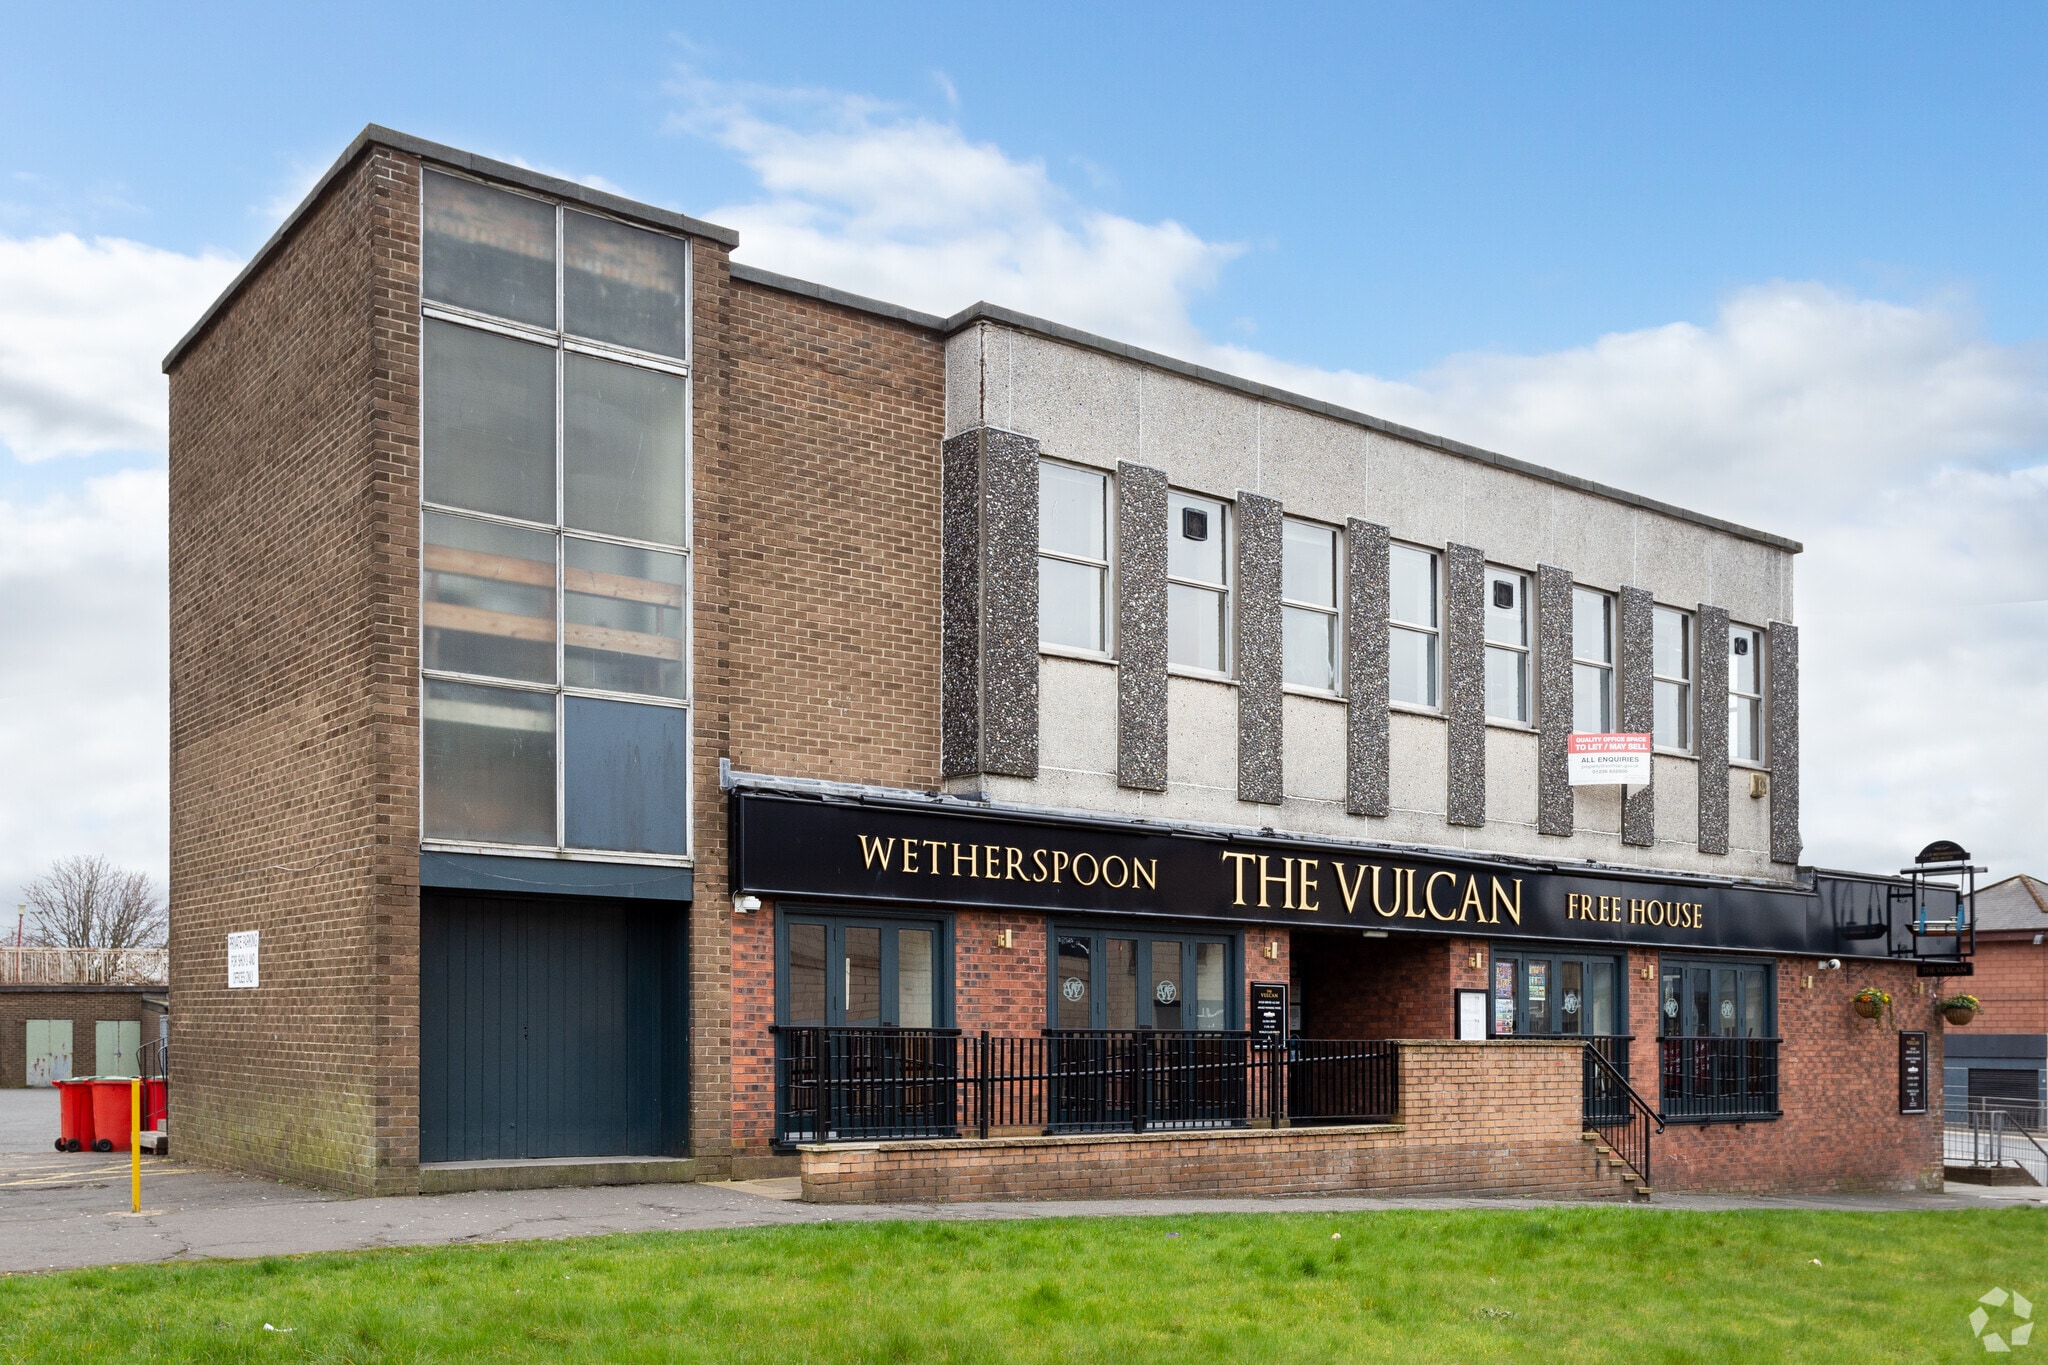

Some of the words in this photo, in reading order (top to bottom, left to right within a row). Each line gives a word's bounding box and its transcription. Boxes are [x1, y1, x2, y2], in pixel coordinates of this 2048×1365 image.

[1575, 743, 1587, 751] TO
[1587, 743, 1603, 751] LET
[858, 834, 1158, 890] WETHERSPOON
[1221, 850, 1320, 912] THE
[1331, 861, 1523, 926] VULCAN
[1568, 892, 1622, 923] FREE
[1630, 898, 1703, 929] HOUSE
